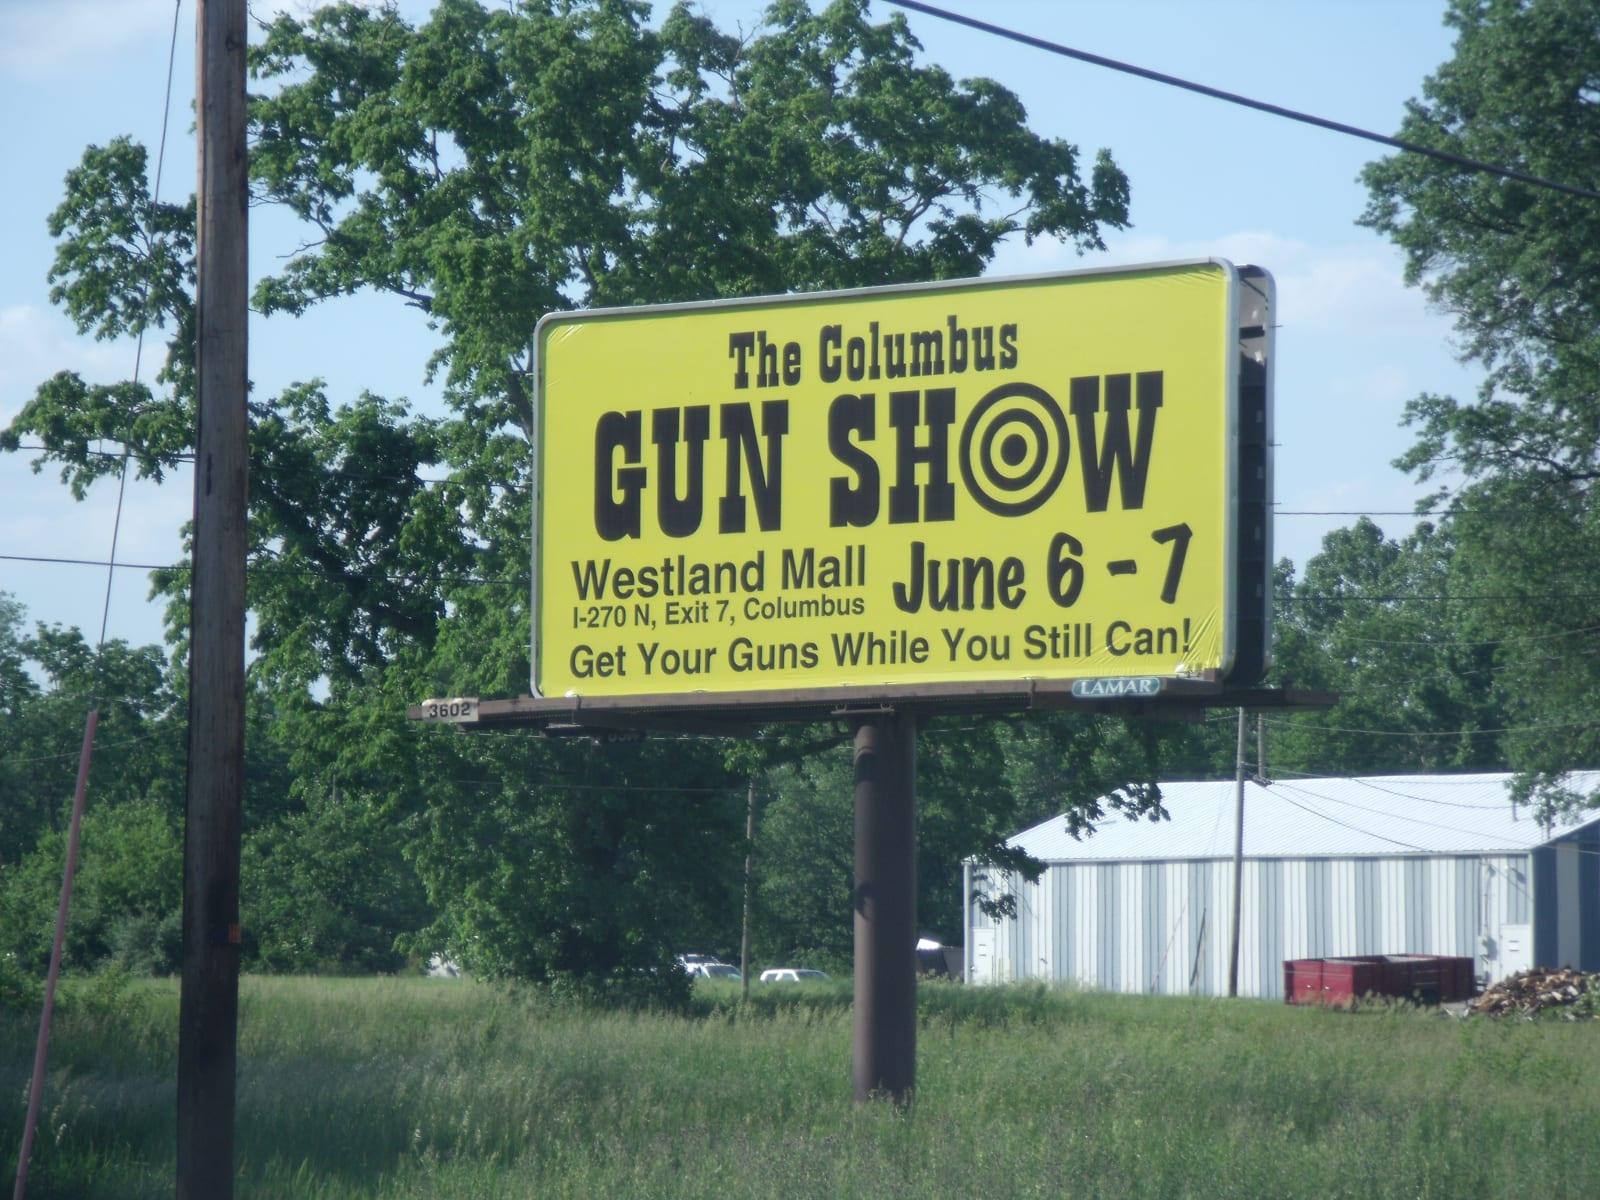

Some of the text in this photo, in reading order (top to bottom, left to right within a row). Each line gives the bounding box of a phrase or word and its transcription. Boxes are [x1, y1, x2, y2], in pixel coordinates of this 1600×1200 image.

[729, 314, 1018, 390] The Columbus
[594, 370, 1164, 543] GUN SHOW
[570, 544, 866, 601] Westland Mall
[892, 541, 1027, 614] June
[572, 594, 865, 630] I-270 N, Exit 7, Columbus
[570, 617, 1191, 678] Get Your Guns While You Still Can!
[429, 702, 471, 718] 3602
[1080, 679, 1152, 696] LAMAR
